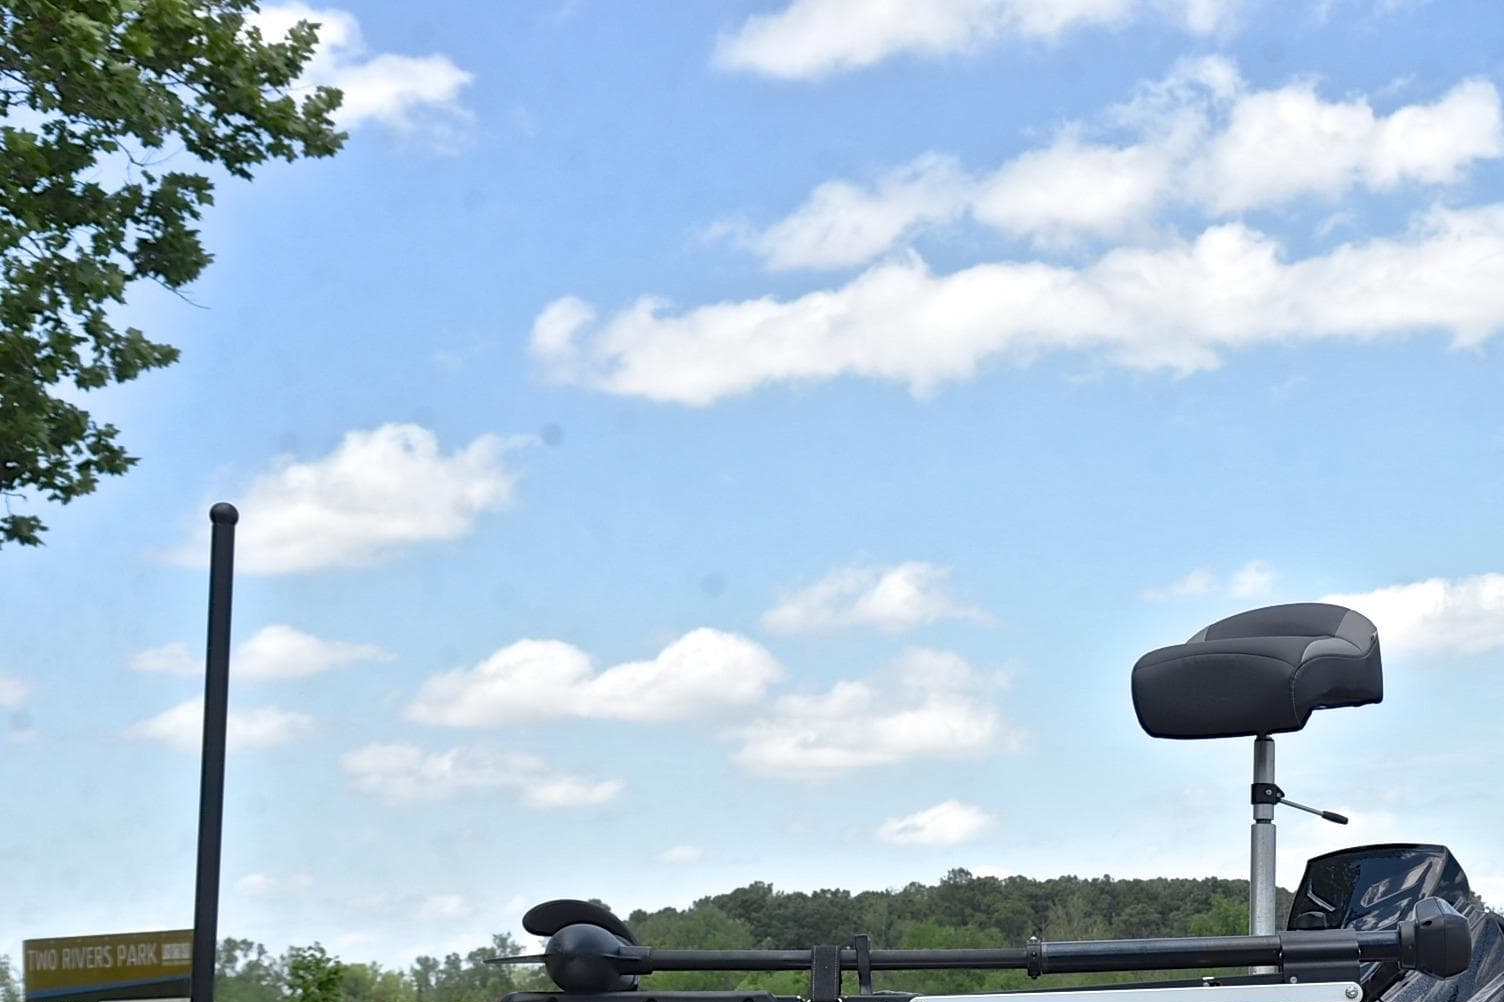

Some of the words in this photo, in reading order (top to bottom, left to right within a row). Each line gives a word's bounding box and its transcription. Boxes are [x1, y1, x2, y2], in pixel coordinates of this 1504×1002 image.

[29, 950, 58, 970] TWO
[62, 946, 114, 969] RIVERS
[117, 943, 158, 966] PARK
